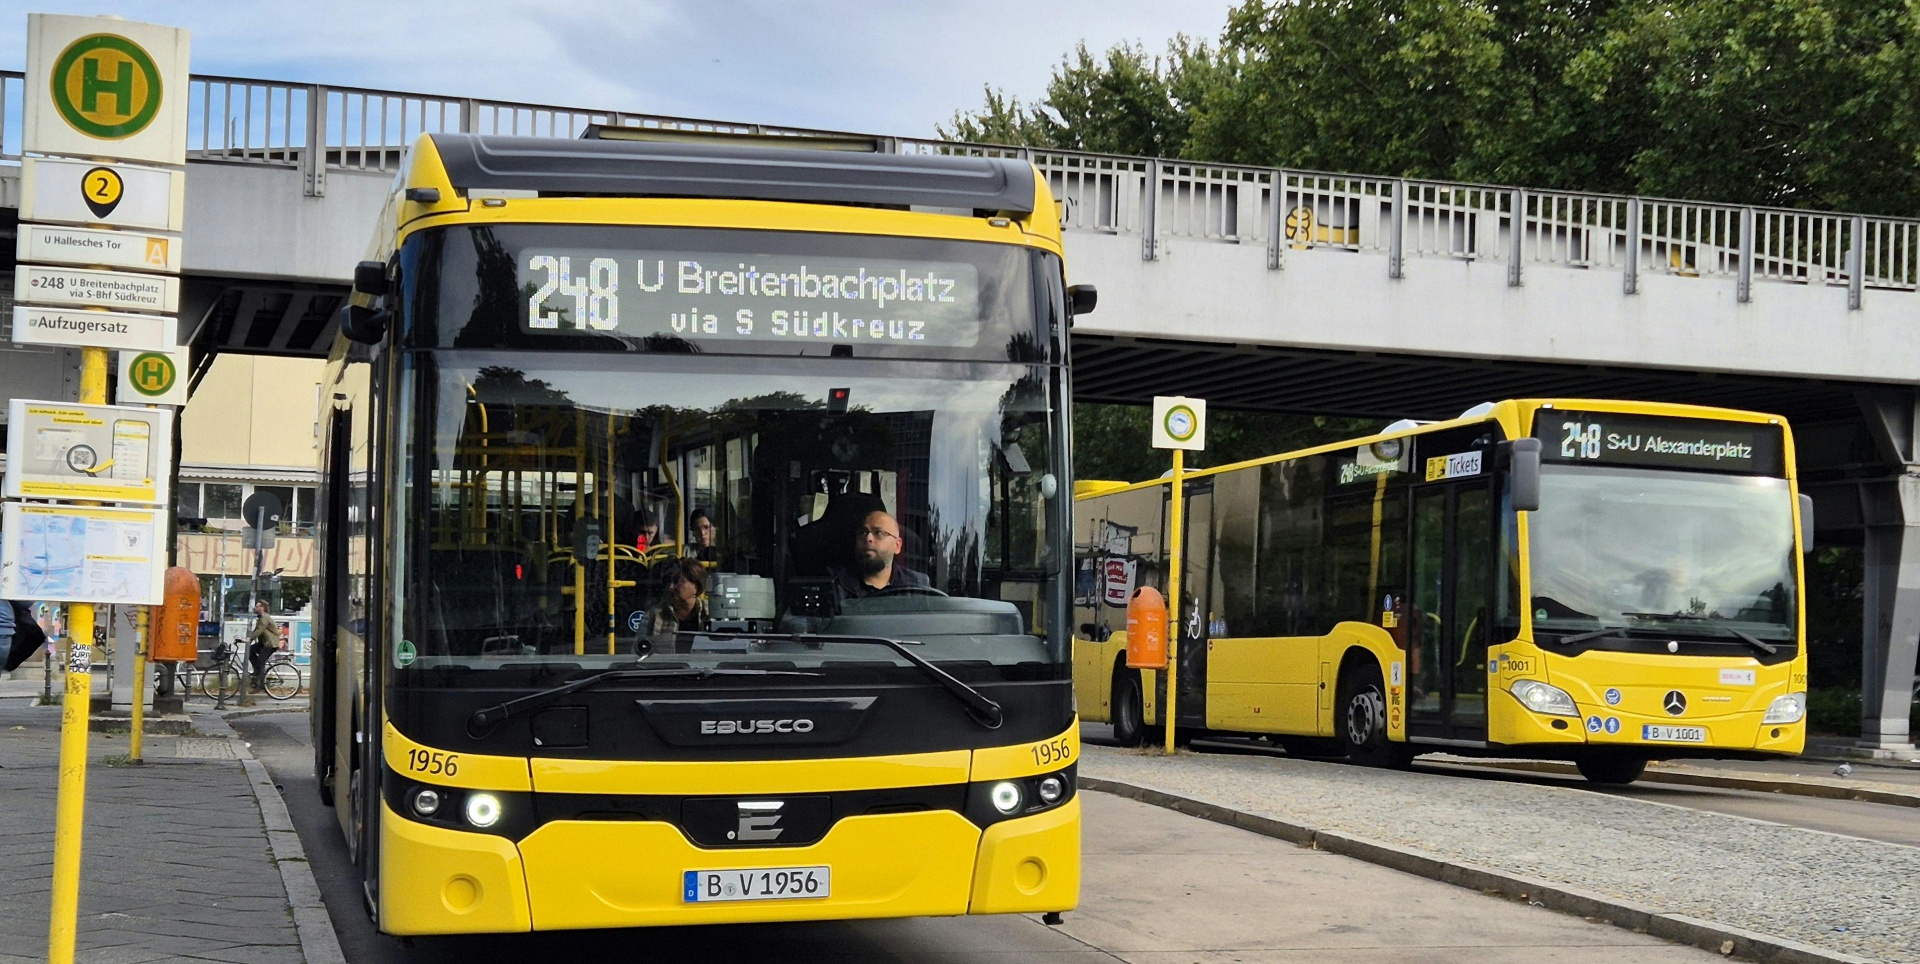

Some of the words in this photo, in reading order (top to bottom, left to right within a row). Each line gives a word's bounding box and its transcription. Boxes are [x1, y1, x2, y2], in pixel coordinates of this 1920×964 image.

[81, 58, 133, 117] H
[95, 177, 109, 197] 2
[44, 236, 52, 244] U
[53, 236, 104, 249] Hallesches
[106, 239, 122, 250] Tor
[147, 243, 167, 268] A
[40, 276, 65, 290] 248
[70, 279, 77, 287] U
[79, 279, 159, 294] Breitenbachplatz
[528, 255, 619, 332] 248
[637, 259, 664, 293] U
[678, 260, 955, 308] Breitenbachplatz
[69, 289, 84, 299] via
[86, 290, 112, 300] S-Bhf
[114, 291, 157, 304] Südkreuz
[37, 316, 129, 334] Aufzugersatz
[671, 306, 718, 334] via
[736, 309, 754, 335] S
[771, 309, 926, 341] Südkreuz
[141, 361, 164, 387] H
[1561, 422, 1602, 459] 248
[1606, 433, 1641, 451] S+U
[1644, 435, 1752, 461] Alexanderplatz
[1448, 455, 1479, 476] Tickets
[402, 641, 409, 653] 4
[1507, 660, 1530, 671] 1001
[700, 719, 815, 735] EBUSCO
[1652, 727, 1660, 739] B
[1666, 728, 1673, 739] V
[1675, 728, 1700, 741] 1001
[406, 748, 458, 777] 1956
[1030, 738, 1071, 767] 1956
[707, 874, 722, 897] B
[739, 873, 753, 896] V
[760, 871, 819, 895] 1956
